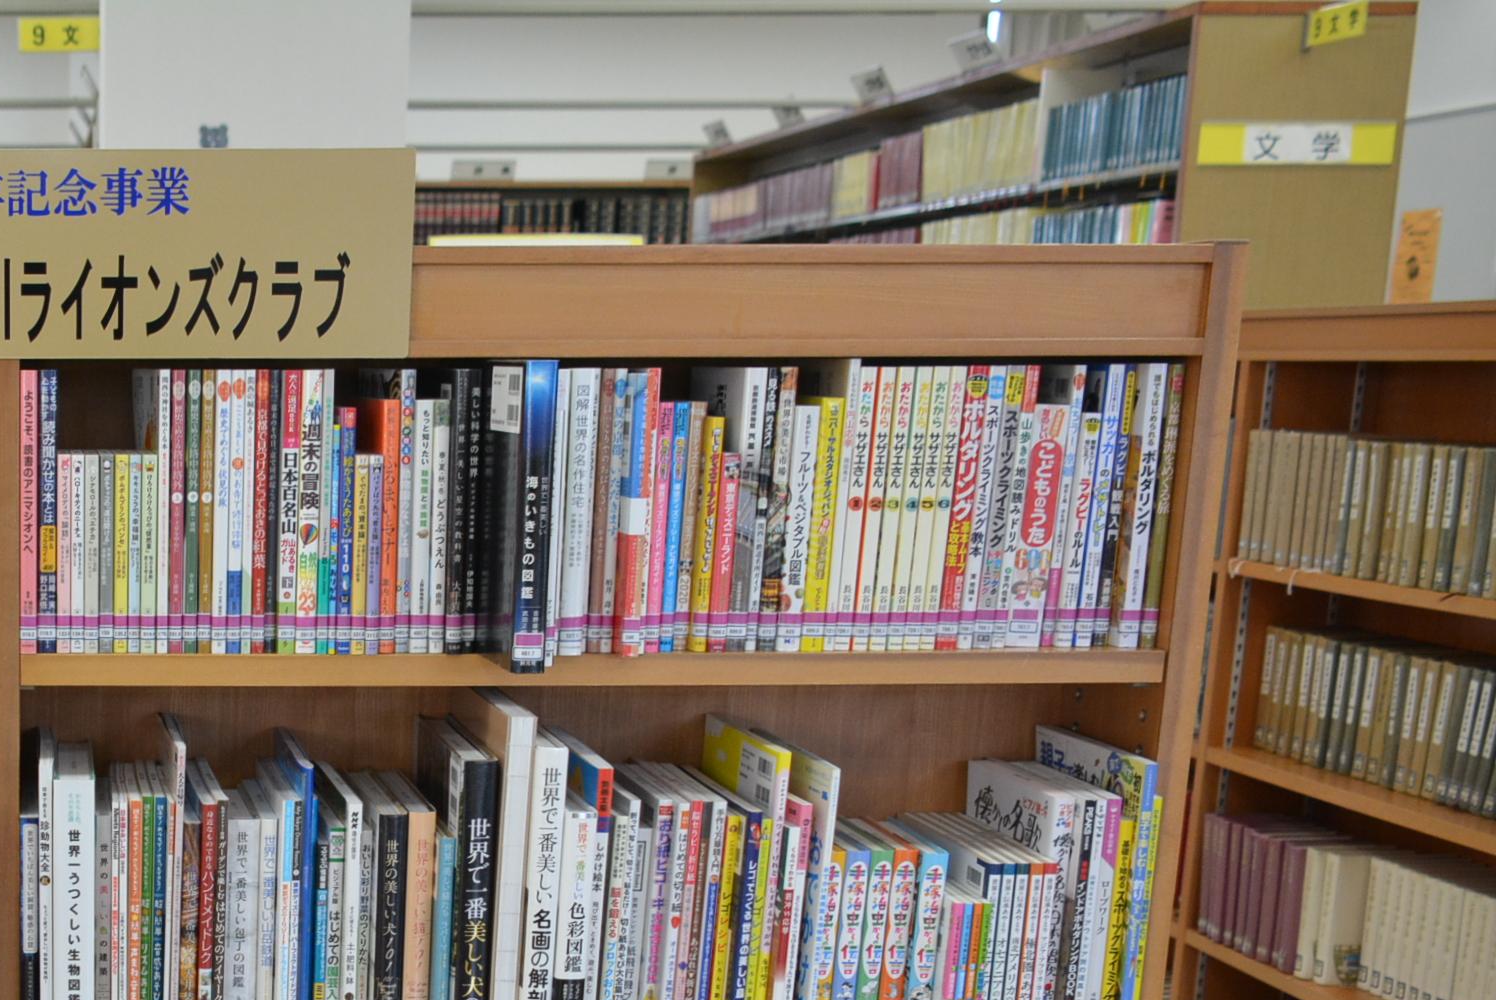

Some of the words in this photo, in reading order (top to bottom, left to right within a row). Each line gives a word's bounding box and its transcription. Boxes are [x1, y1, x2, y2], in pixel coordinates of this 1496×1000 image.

[32, 26, 45, 46] 9
[62, 25, 80, 46] 文
[1255, 133, 1281, 161] 文
[1311, 131, 1341, 161] 学
[281, 451, 299, 535] 日本百名山
[300, 424, 322, 510] 週末の冒険
[1028, 442, 1055, 546] こどものうた
[1135, 450, 1157, 536] ボルダリング
[521, 475, 539, 600] 海のいきもの図鑑
[563, 901, 586, 973] 色彩図鑑
